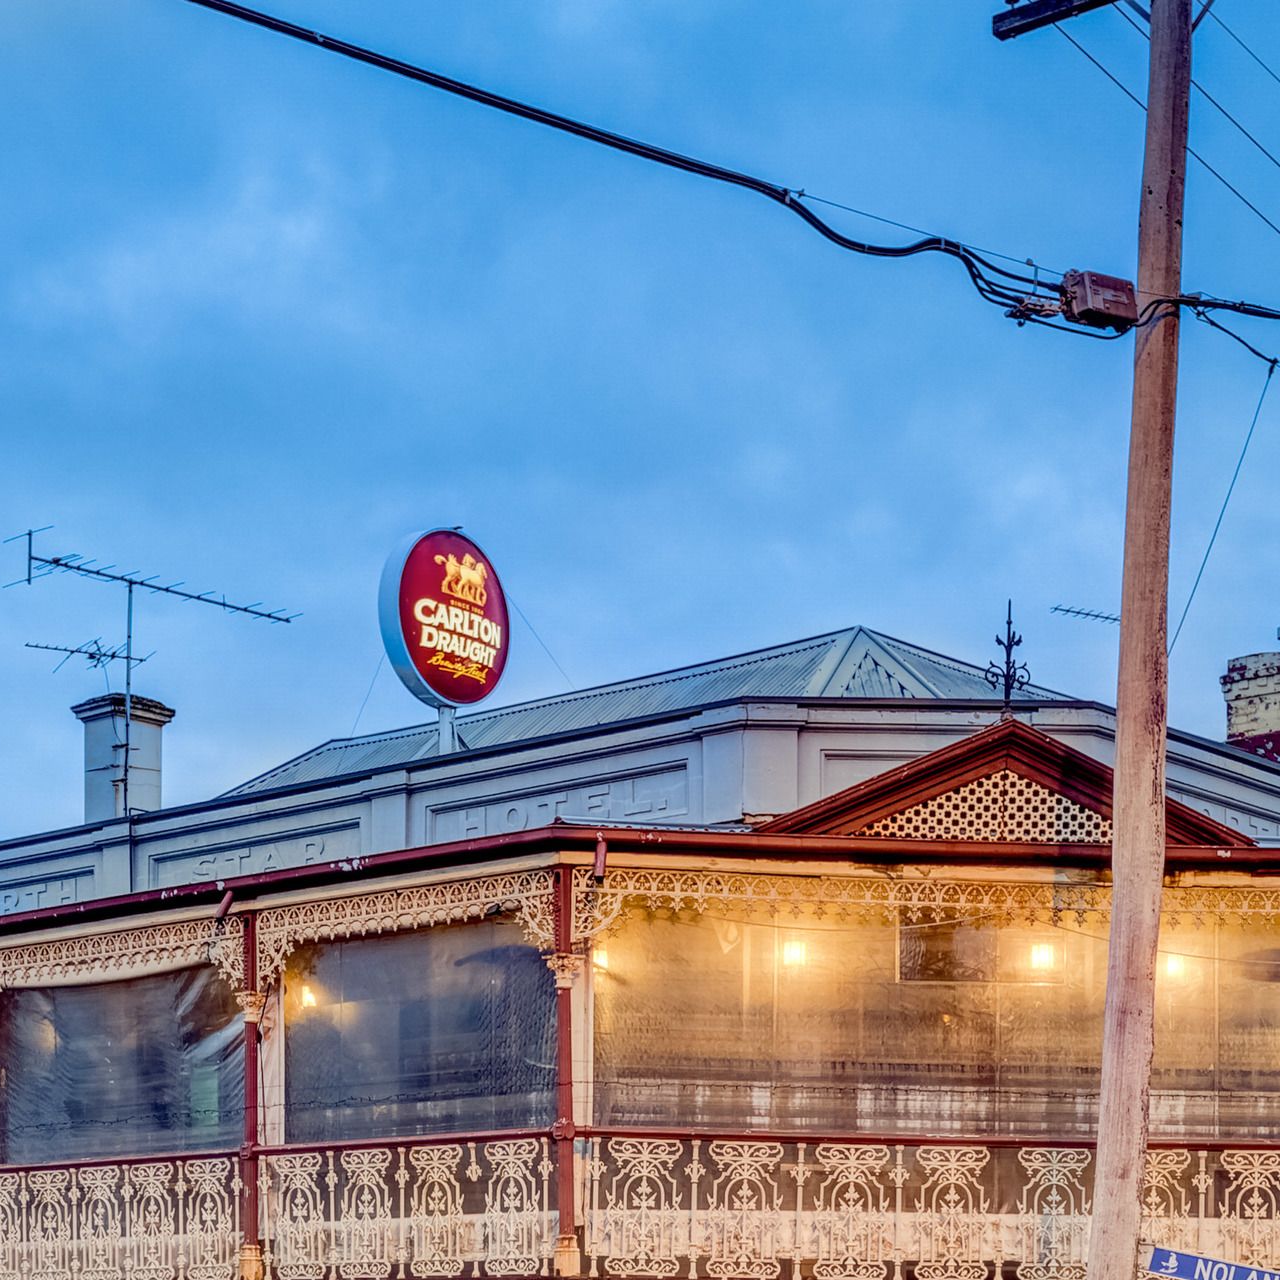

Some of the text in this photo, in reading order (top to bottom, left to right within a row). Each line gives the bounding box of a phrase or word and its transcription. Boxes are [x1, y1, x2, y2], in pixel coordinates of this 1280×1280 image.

[414, 598, 501, 649] CARLTON
[419, 625, 497, 668] DRAUGHT
[465, 778, 668, 838] HOTEL
